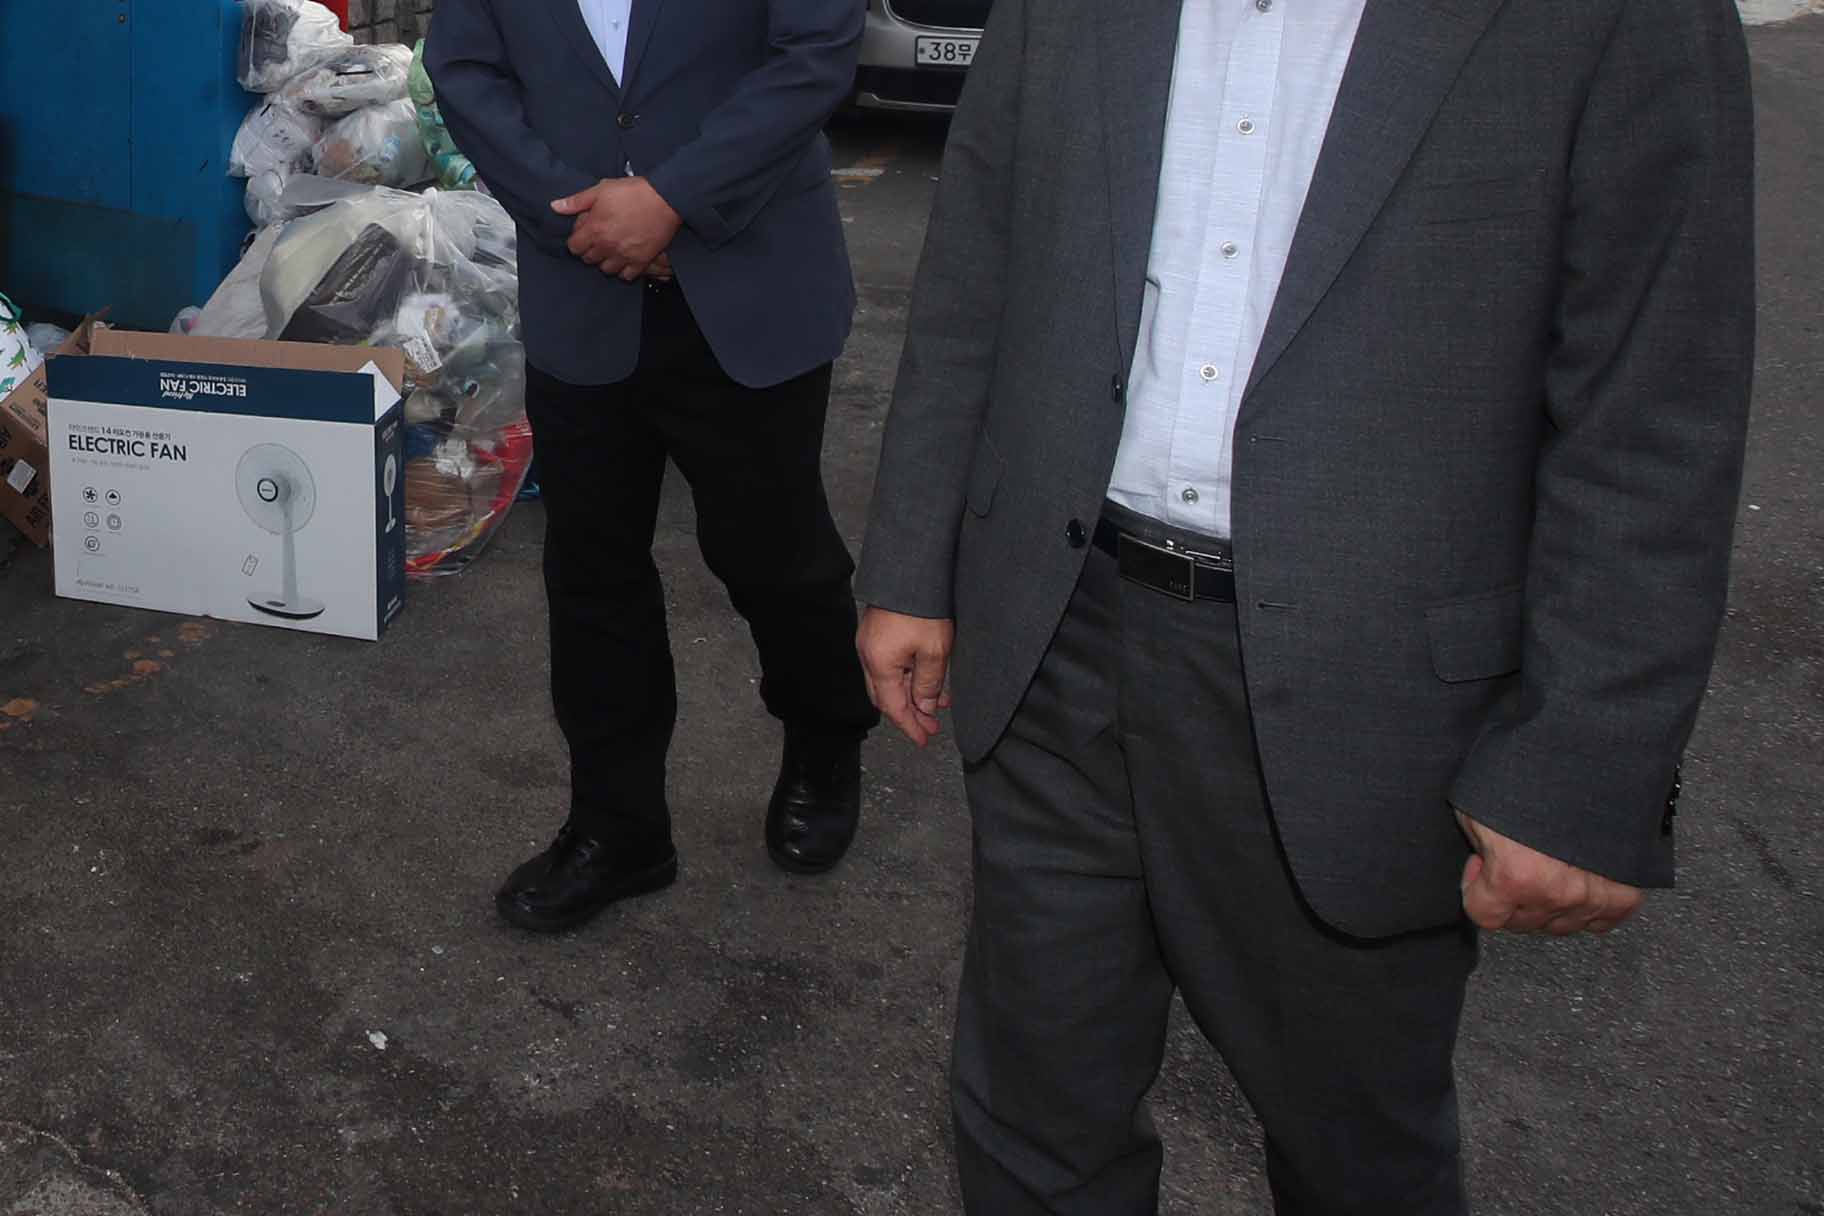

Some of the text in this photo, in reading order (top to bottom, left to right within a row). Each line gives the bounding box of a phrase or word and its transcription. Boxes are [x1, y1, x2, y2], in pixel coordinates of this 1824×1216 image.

[160, 378, 186, 391] FAN
[189, 381, 247, 397] ELECTRIC
[69, 434, 187, 462] ELECTRIC FAN
